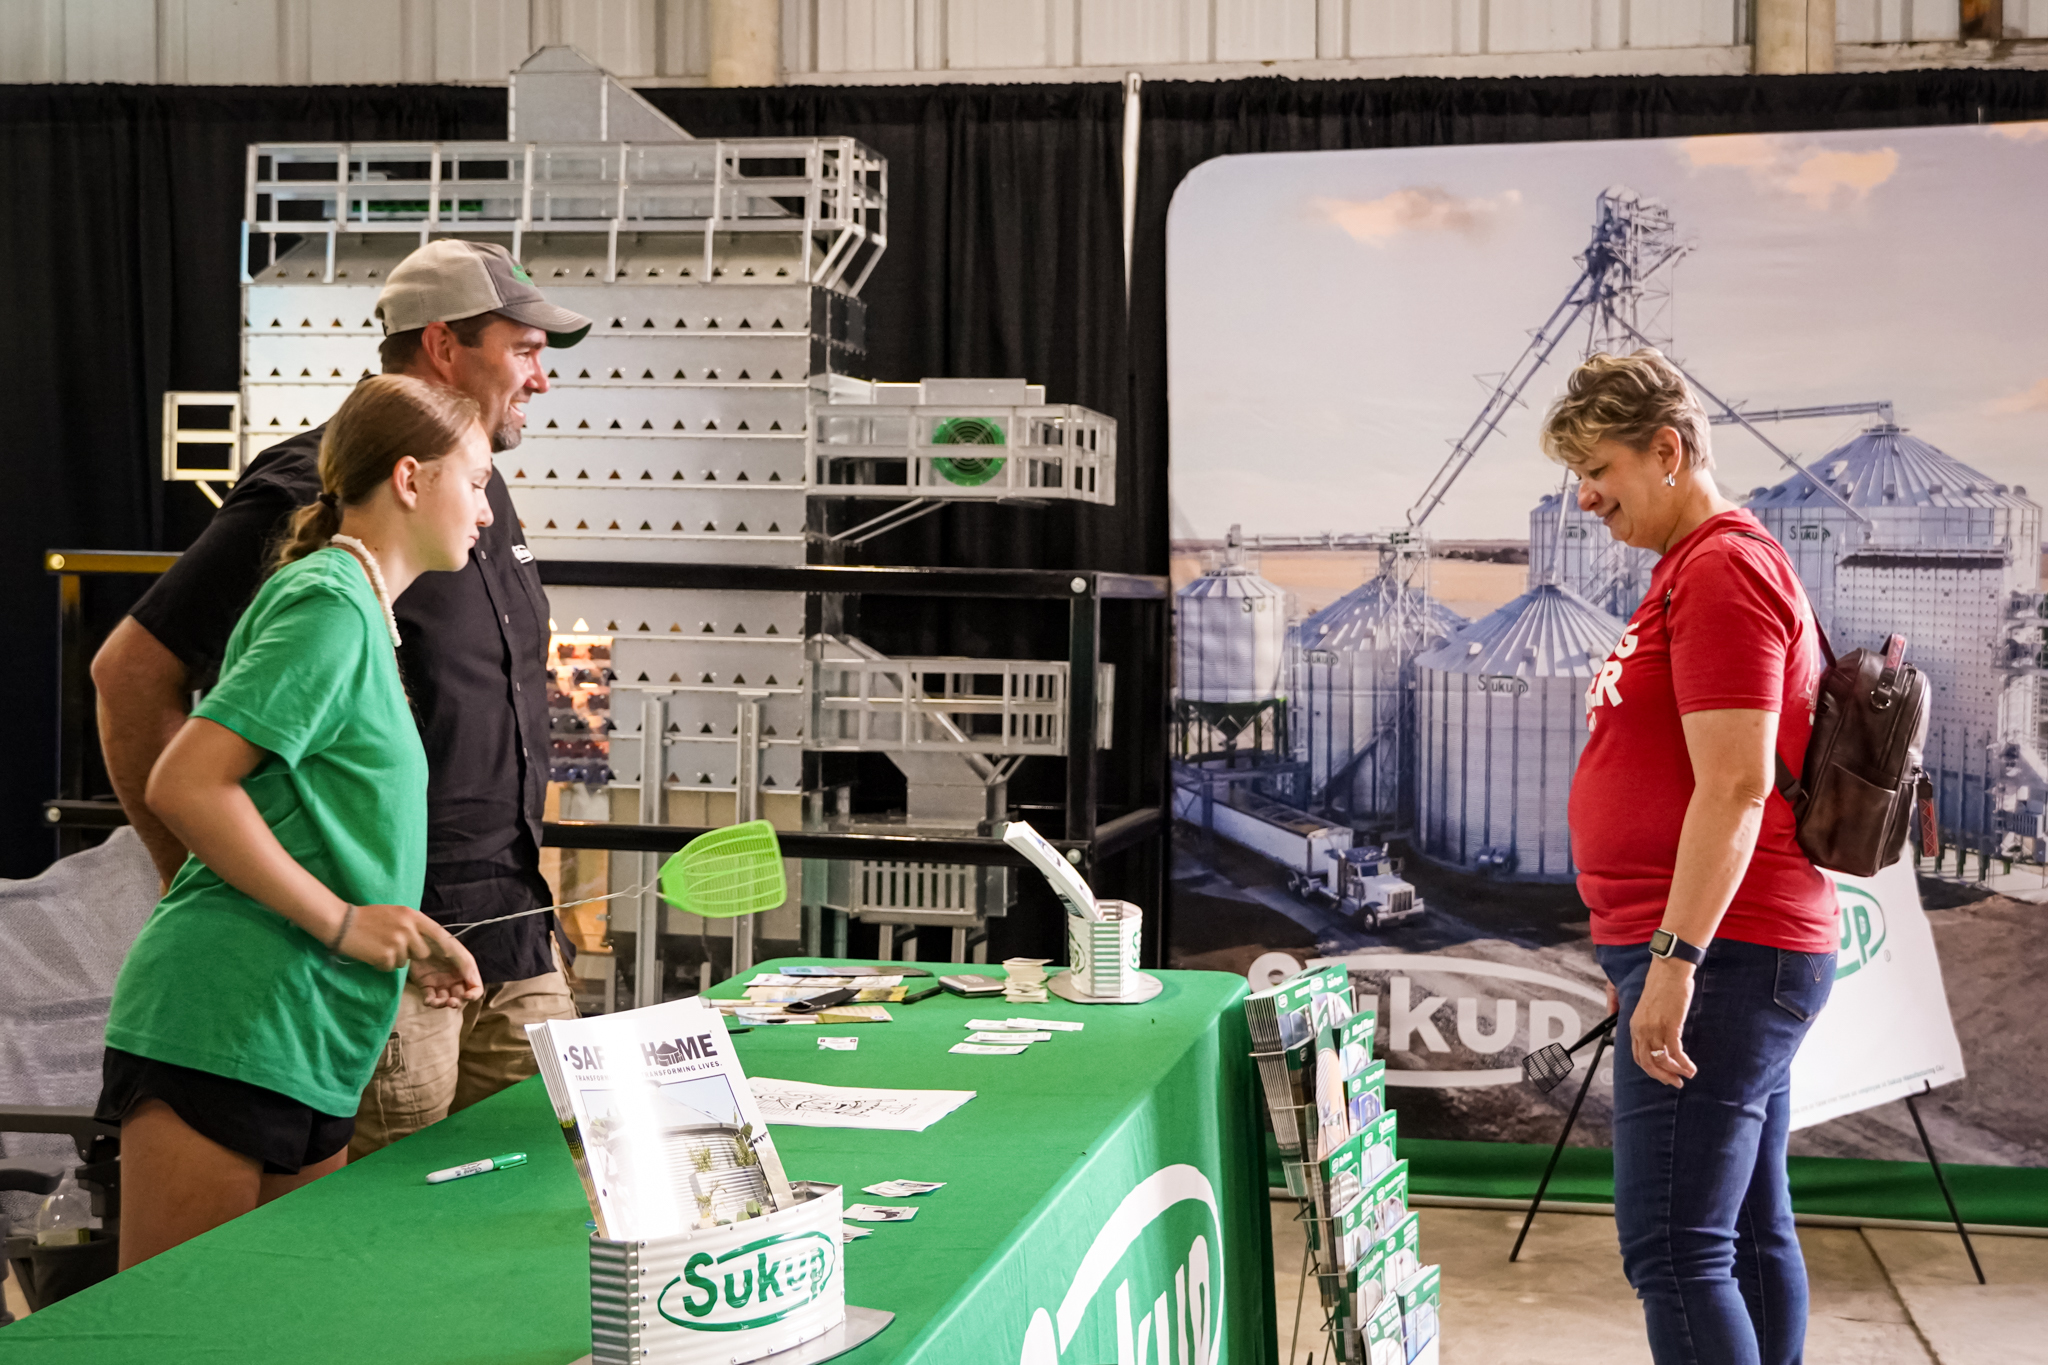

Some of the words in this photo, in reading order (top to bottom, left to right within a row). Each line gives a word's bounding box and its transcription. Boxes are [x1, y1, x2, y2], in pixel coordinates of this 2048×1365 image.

[1477, 674, 1526, 697] Sukup
[568, 1045, 605, 1071] SAF
[698, 1060, 723, 1071] LIVES.
[682, 1247, 826, 1318] Sukup
